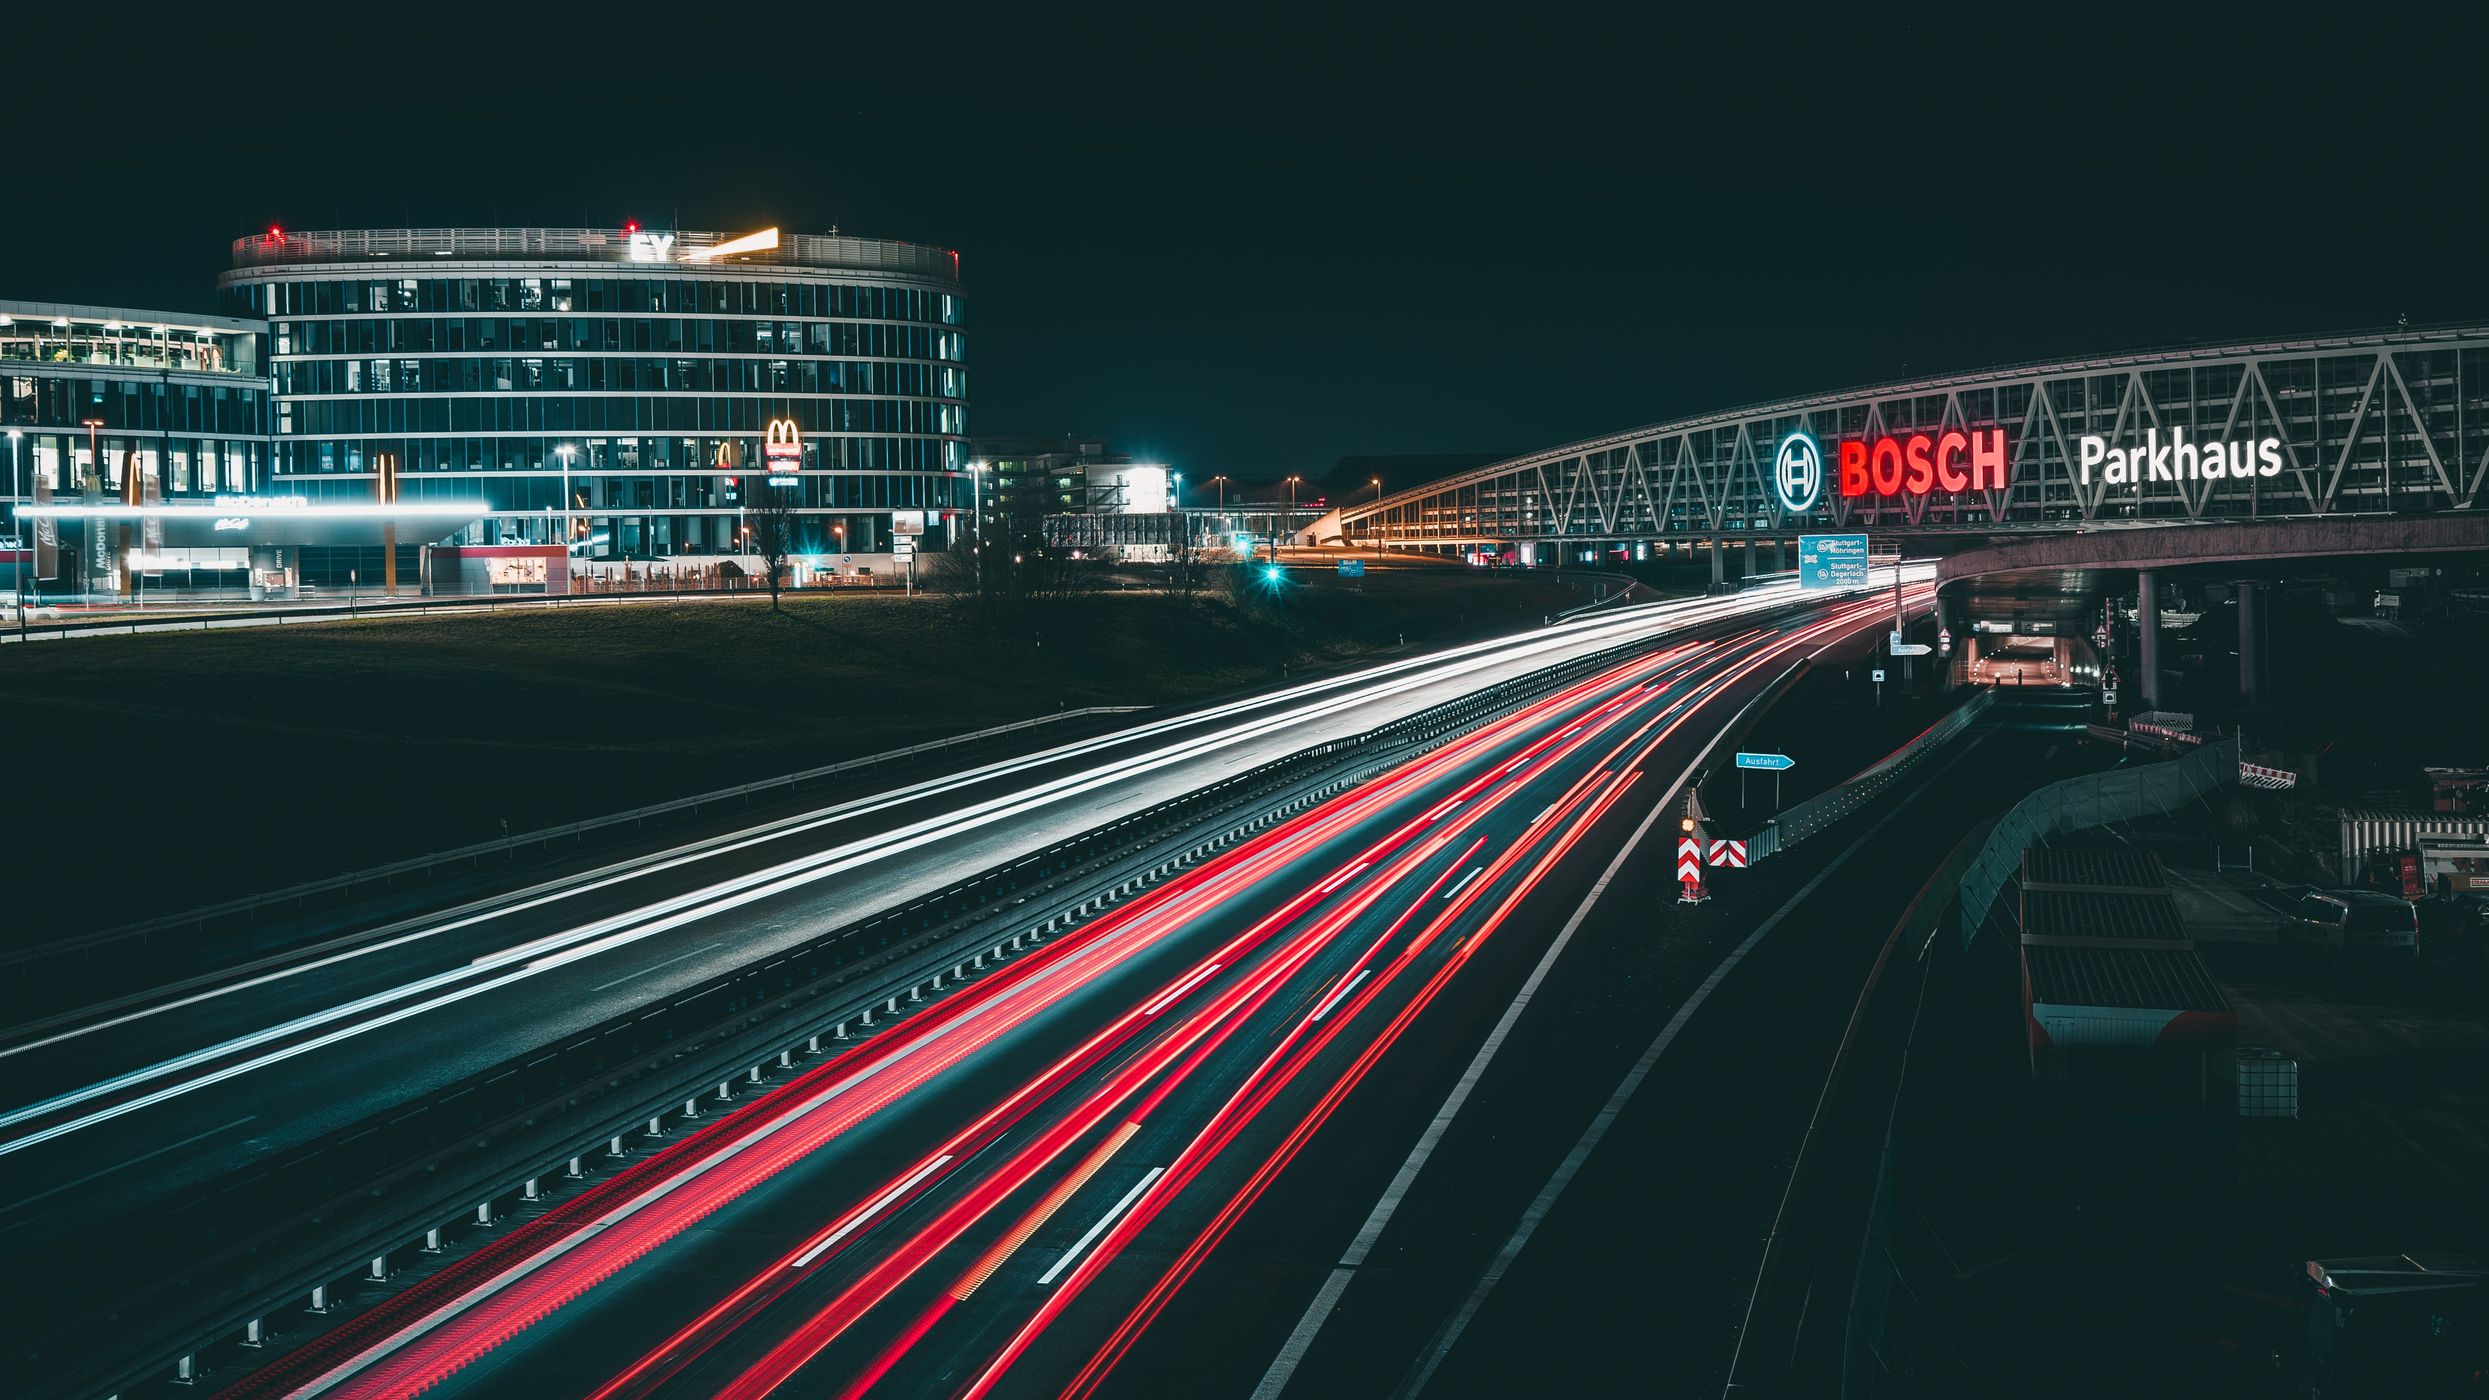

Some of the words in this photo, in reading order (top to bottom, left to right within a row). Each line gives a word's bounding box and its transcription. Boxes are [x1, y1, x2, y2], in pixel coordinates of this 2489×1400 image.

[631, 234, 675, 262] EY
[1841, 429, 2006, 497] BOSCH
[2080, 426, 2283, 486] Parkhaus
[1745, 757, 1779, 766] Ausfahrt
